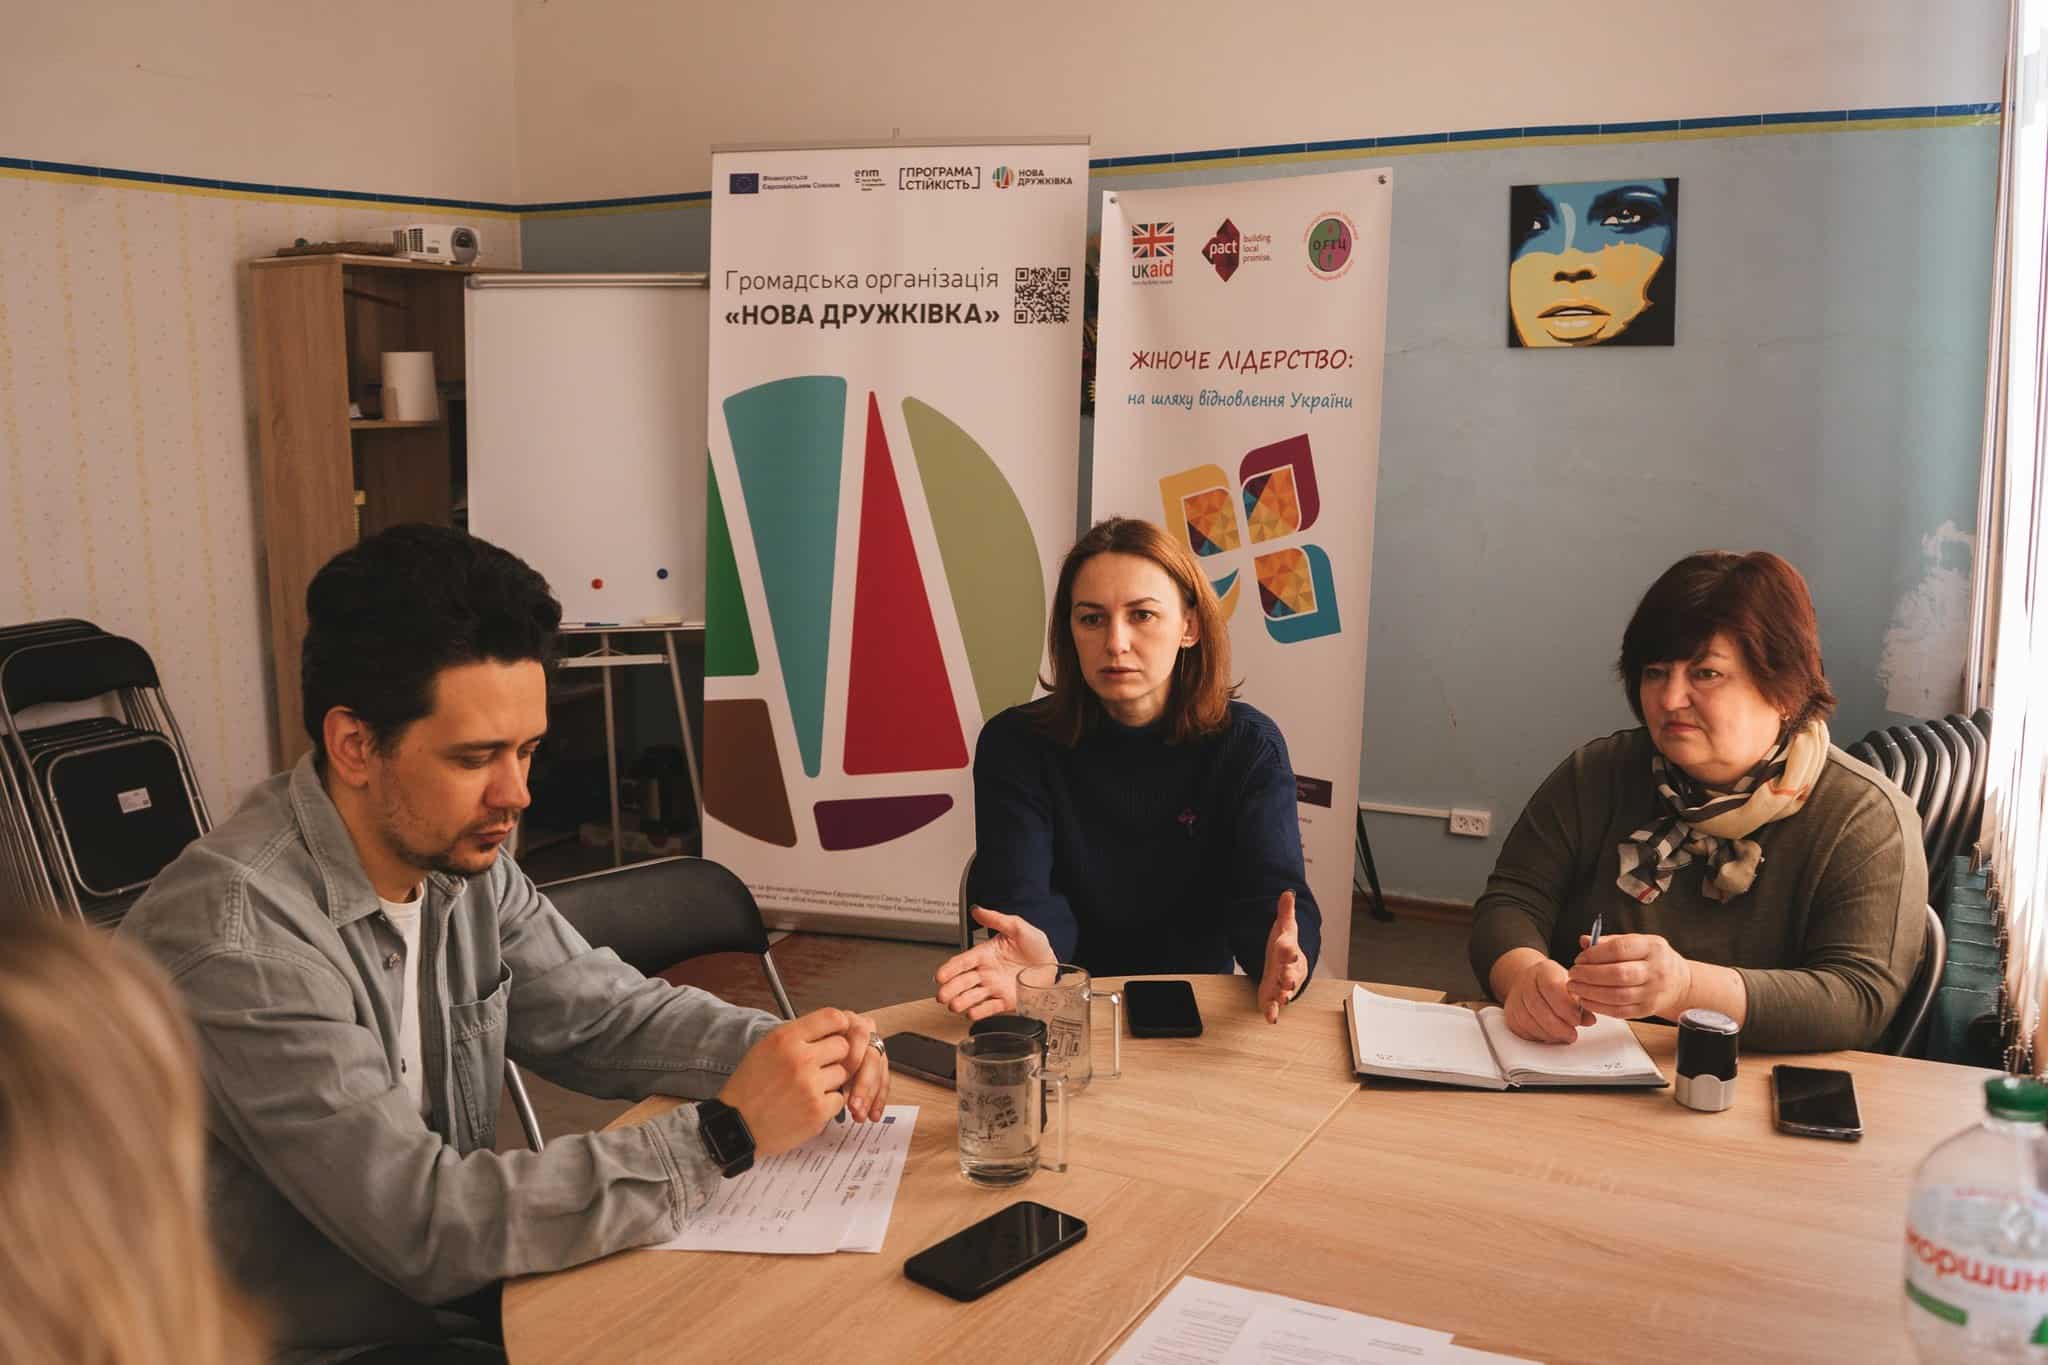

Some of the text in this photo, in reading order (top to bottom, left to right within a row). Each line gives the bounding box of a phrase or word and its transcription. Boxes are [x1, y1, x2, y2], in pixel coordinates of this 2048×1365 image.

[905, 166, 974, 177] ПРОГРАМА
[1017, 177, 1073, 186] ДРУЖКІВКА
[905, 178, 970, 190] СТІЙКІСТЬ
[1210, 239, 1237, 258] pact
[1132, 259, 1174, 279] UKaid
[725, 266, 999, 295] Громадська організація
[725, 303, 1000, 329] «НОВА ДРУЖКІВКА»
[1129, 349, 1354, 375] ЖІНОЧЕ ЛІДЕРСТВО:
[1127, 388, 1353, 414] на шляху відновлення України
